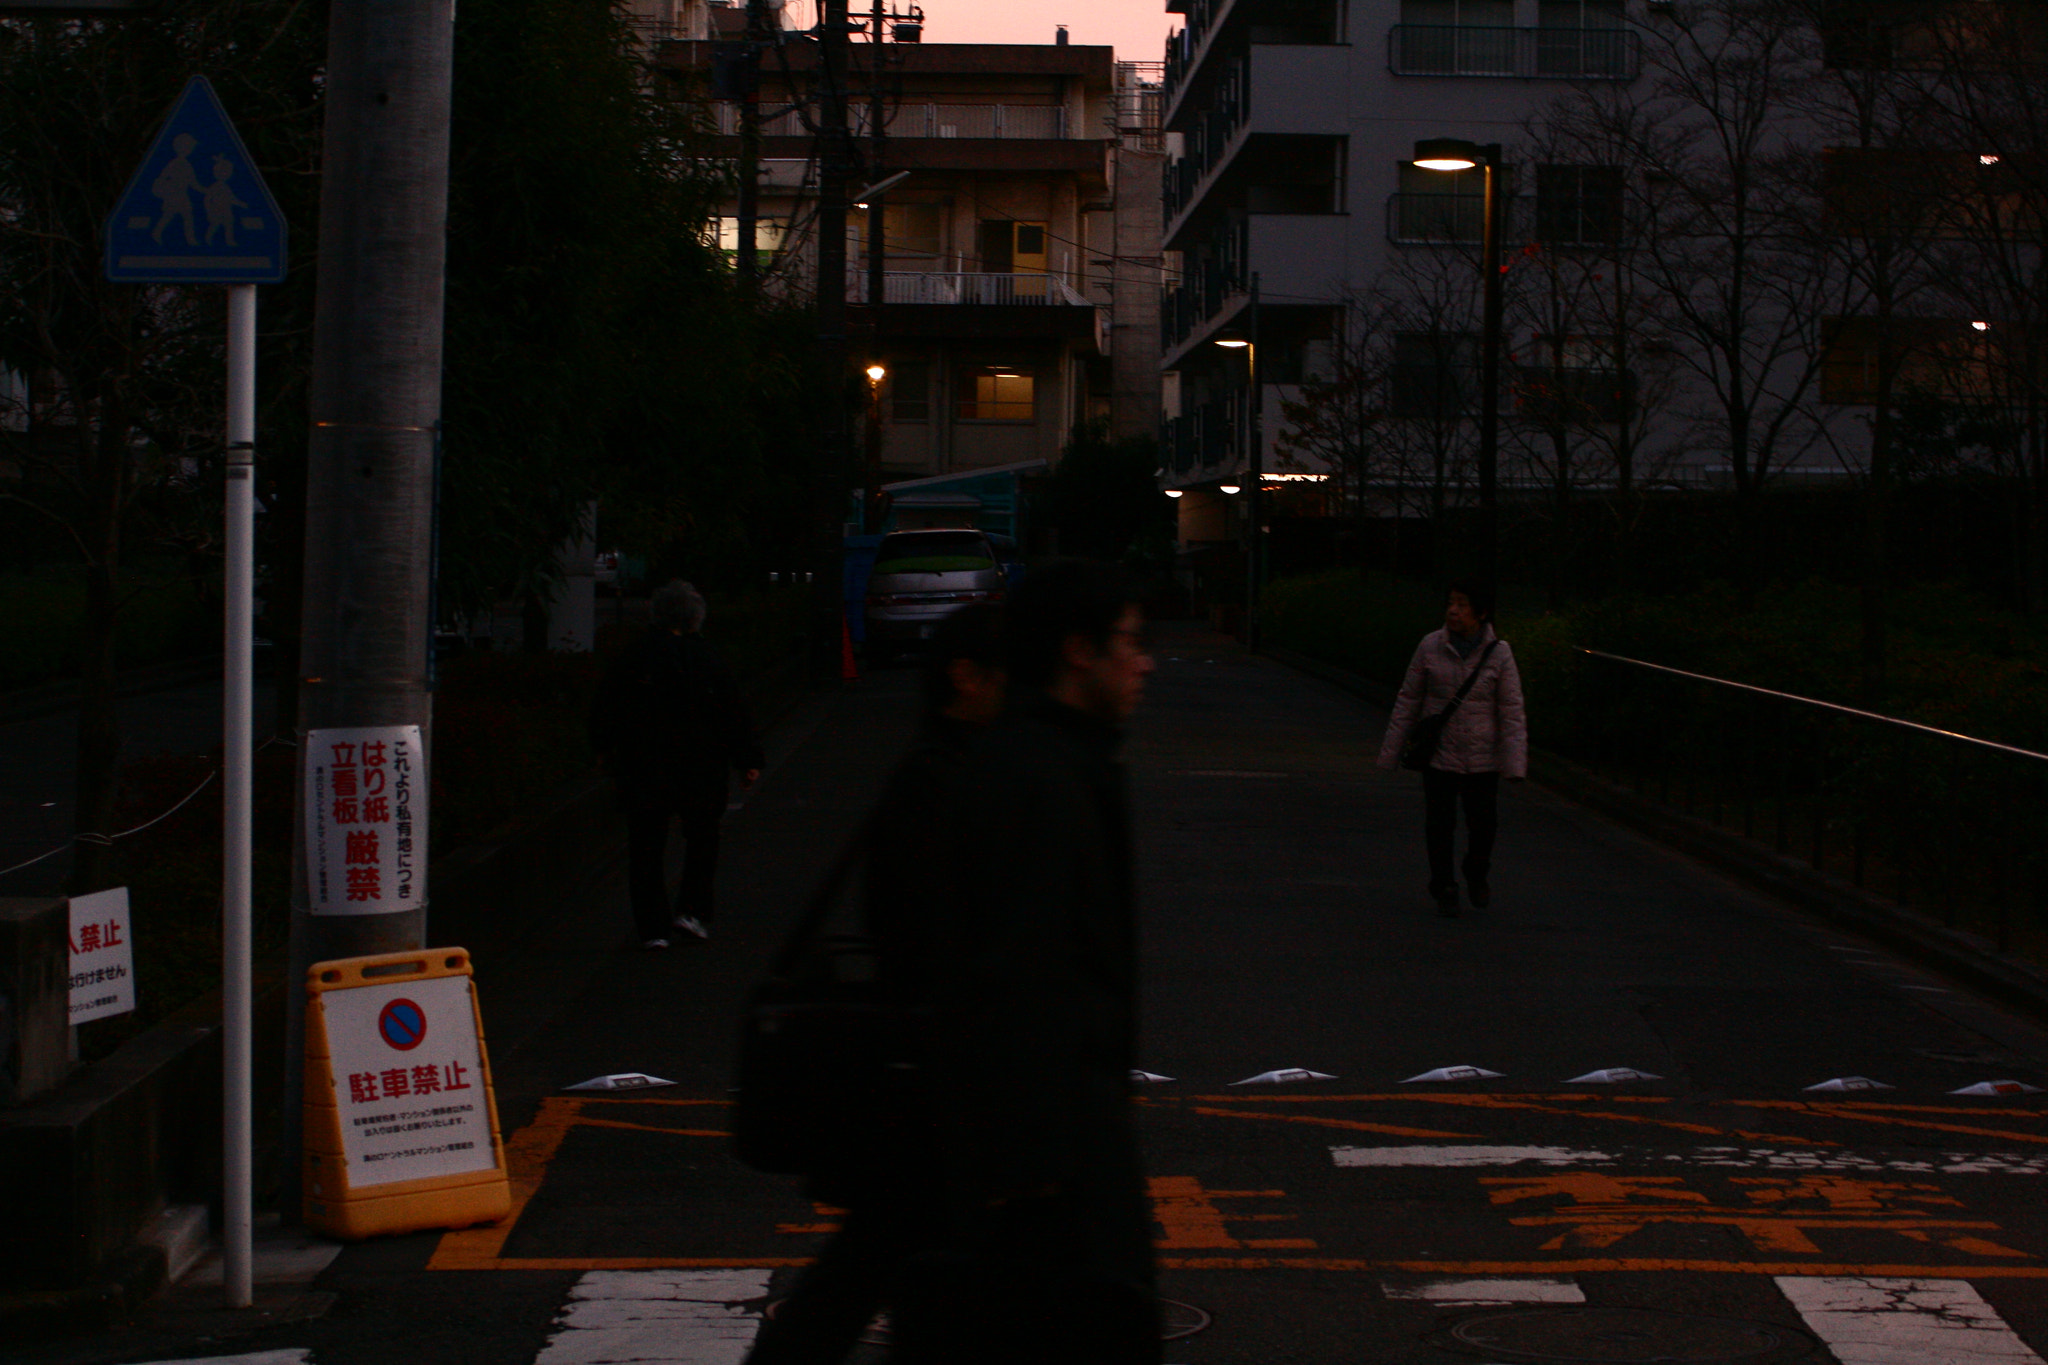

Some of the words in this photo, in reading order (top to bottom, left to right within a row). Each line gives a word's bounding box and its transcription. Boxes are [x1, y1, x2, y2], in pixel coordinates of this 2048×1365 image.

[330, 741, 359, 825] 立看板
[362, 740, 390, 824] はり紙
[345, 830, 381, 902] 厳禁
[348, 1060, 471, 1104] 駐車禁止
